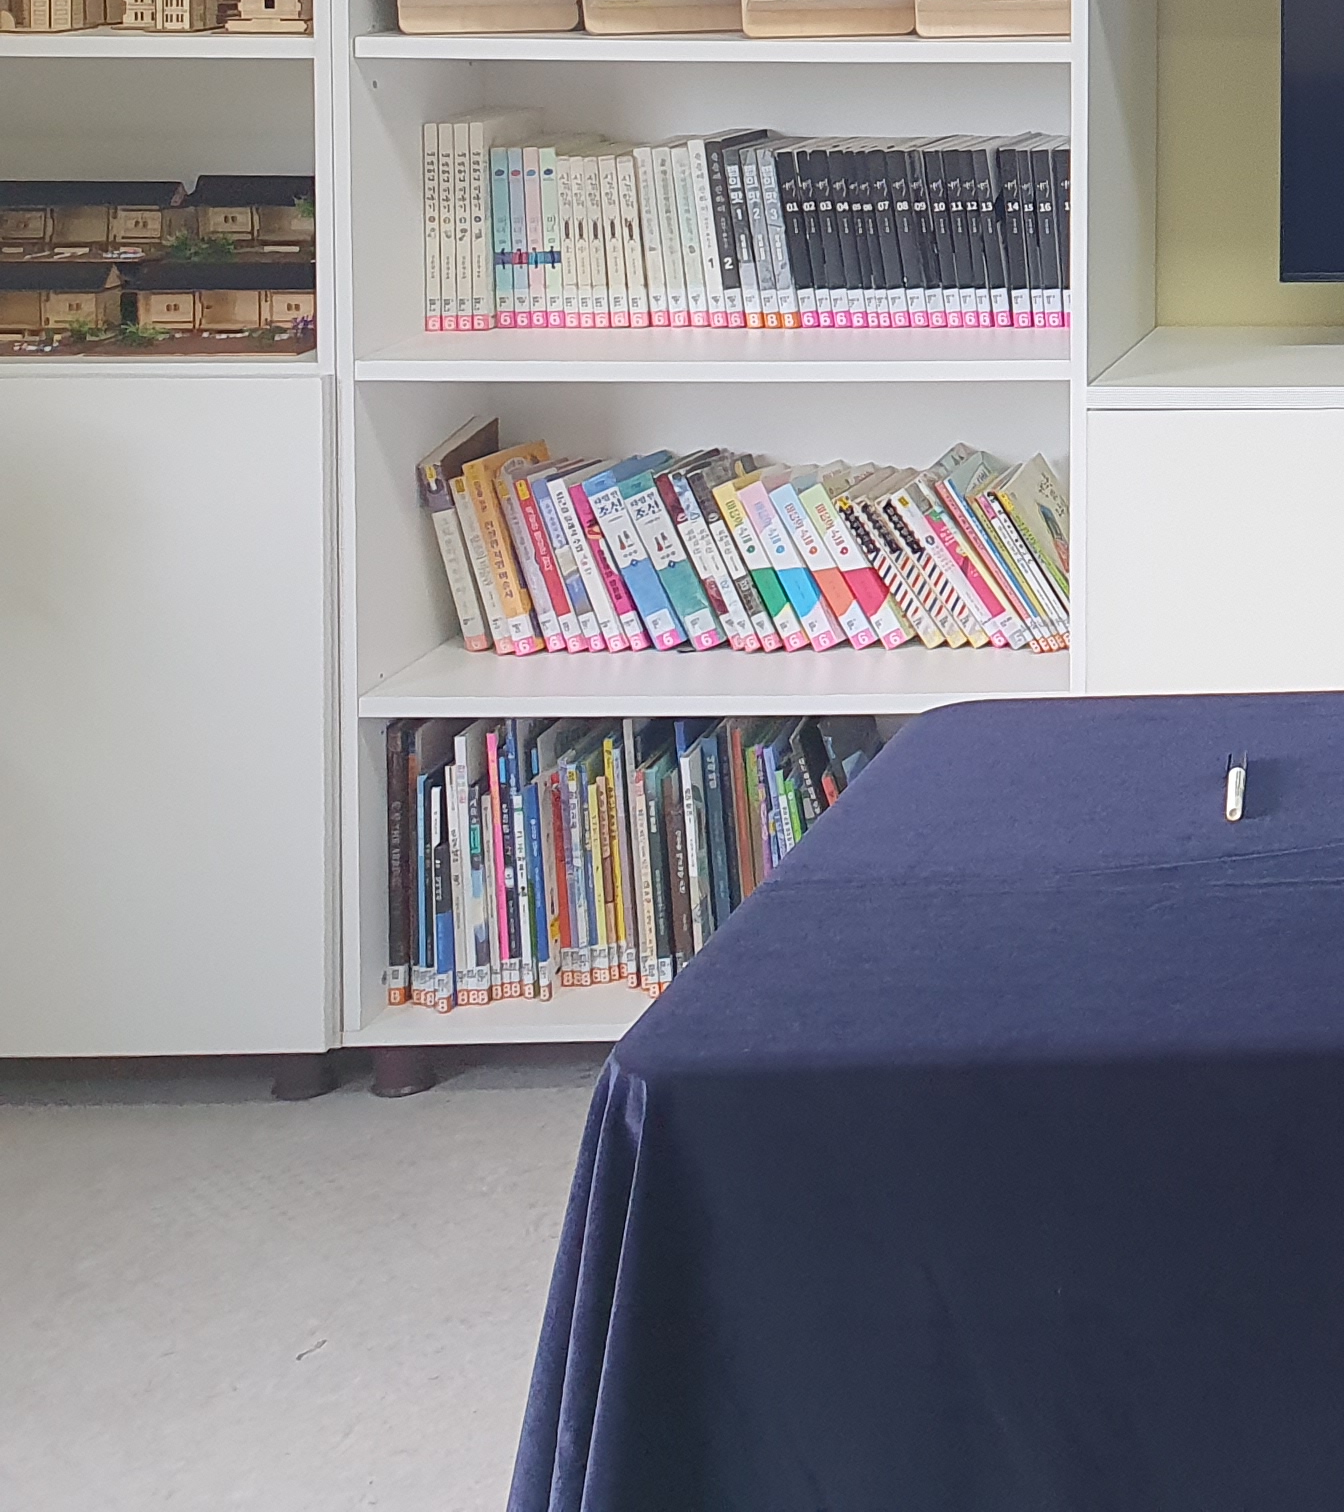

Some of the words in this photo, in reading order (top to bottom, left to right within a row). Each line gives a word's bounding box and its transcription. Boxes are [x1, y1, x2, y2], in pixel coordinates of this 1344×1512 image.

[786, 201, 799, 212] 01
[803, 201, 815, 211] 02
[819, 201, 832, 211] 03
[836, 201, 849, 212] 04
[877, 201, 889, 211] 07
[897, 201, 909, 211] 08
[914, 201, 926, 211] 09
[933, 202, 946, 212] 10
[951, 201, 963, 211] 11
[966, 201, 978, 210] 12
[981, 202, 993, 212] 13
[1007, 201, 1019, 211] 14
[1024, 203, 1033, 212] 15
[1039, 202, 1052, 212] 16
[736, 208, 743, 221] 1
[752, 208, 761, 220] 2
[769, 208, 778, 220] 3
[723, 257, 734, 270] 2
